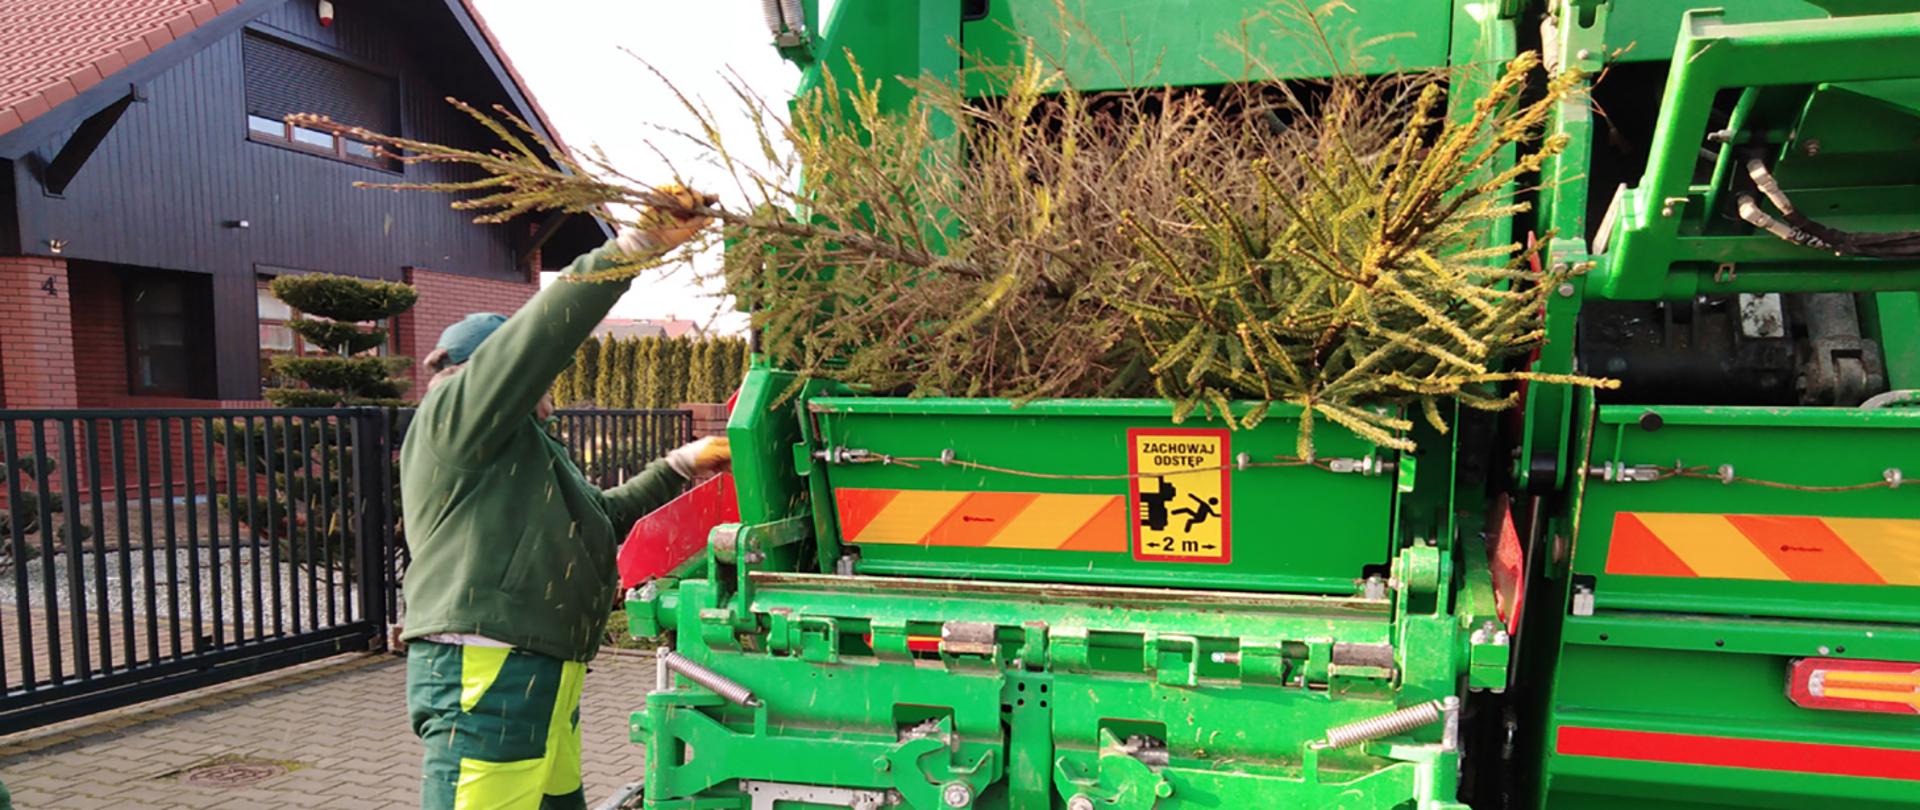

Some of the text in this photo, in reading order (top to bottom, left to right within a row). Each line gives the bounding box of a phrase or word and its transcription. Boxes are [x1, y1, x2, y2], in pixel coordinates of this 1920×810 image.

[41, 276, 57, 296] 4
[1143, 443, 1215, 454] ZACHOWAJ
[1154, 455, 1204, 467] ODSTĘP
[1163, 537, 1198, 552] 2 m
